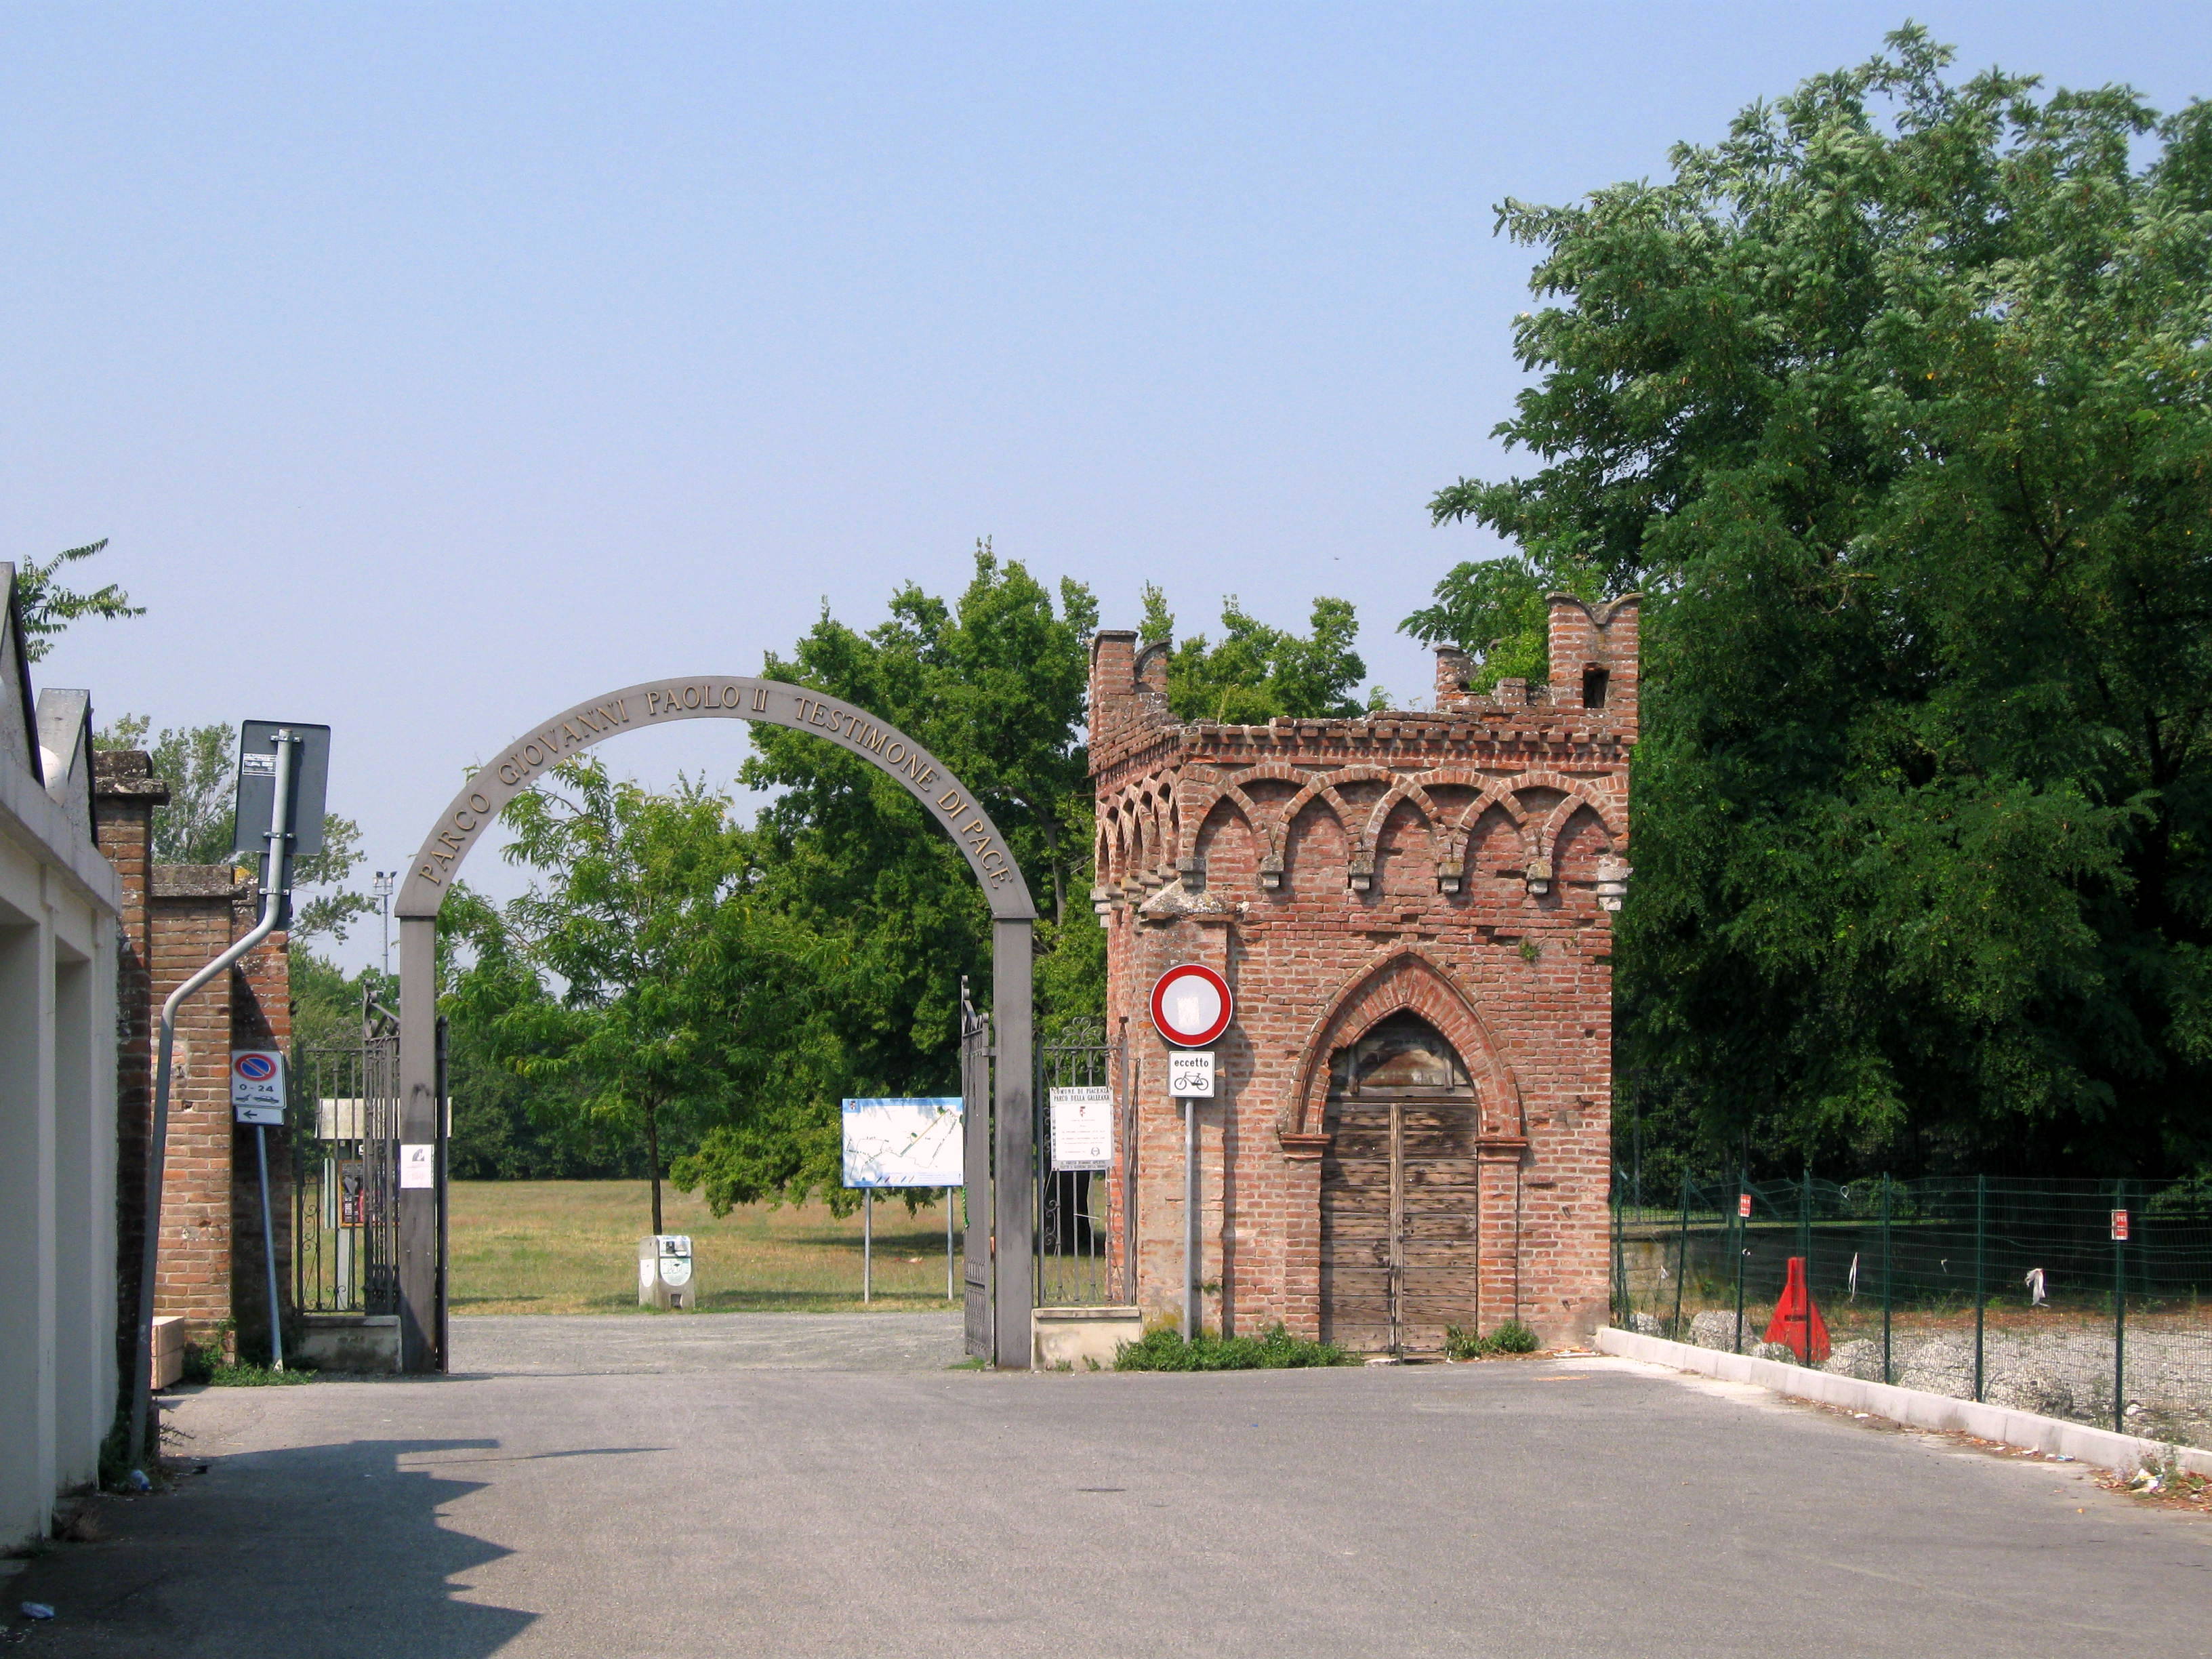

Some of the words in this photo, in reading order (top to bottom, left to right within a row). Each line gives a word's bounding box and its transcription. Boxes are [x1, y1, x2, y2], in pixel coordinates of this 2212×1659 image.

[419, 793, 490, 886] PARCO
[498, 699, 630, 786] GIOVANNI
[645, 684, 739, 715] PAOLO
[752, 687, 768, 712] II
[796, 697, 939, 792] TESTIMONE
[937, 787, 969, 820] DI
[960, 818, 1013, 889] PACE
[1174, 1058, 1208, 1067] eccetto
